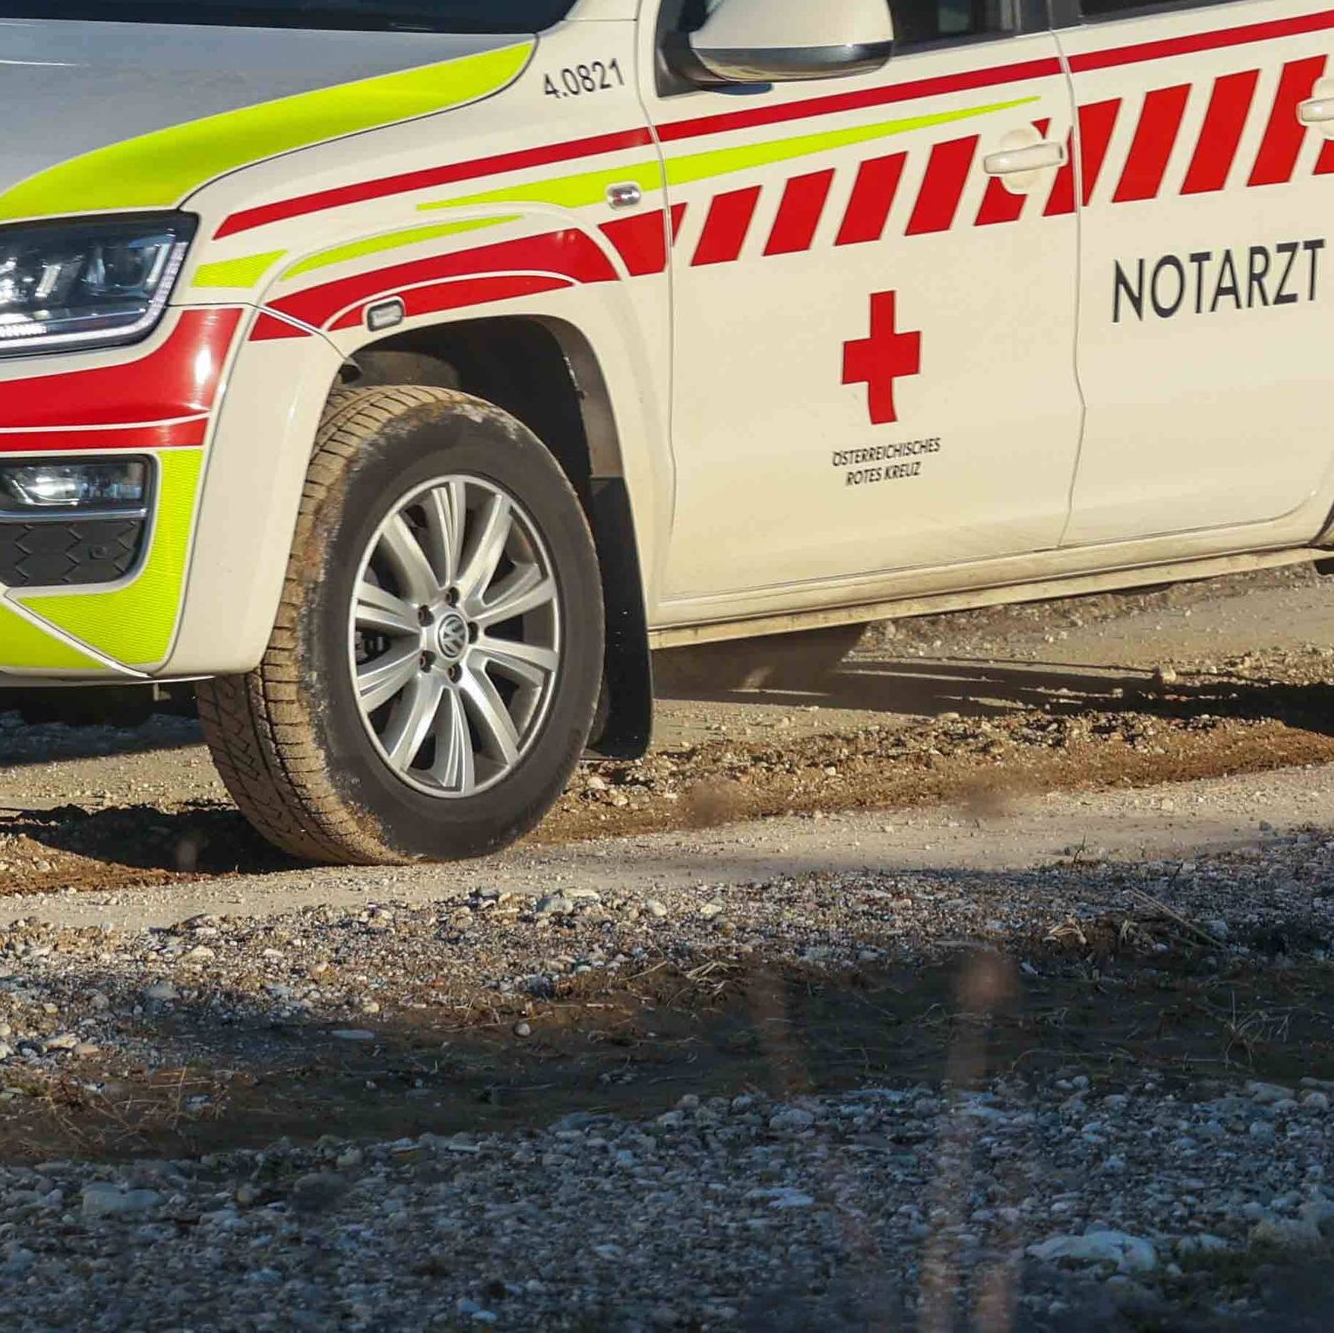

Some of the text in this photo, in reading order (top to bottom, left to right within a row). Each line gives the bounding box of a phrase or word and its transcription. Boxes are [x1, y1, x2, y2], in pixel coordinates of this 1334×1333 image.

[544, 57, 625, 99] 4.0821
[1112, 239, 1325, 323] NOTARZT
[832, 437, 941, 466] ÖSTERREICHISCHES
[845, 461, 921, 486] ROTES KREUZ
